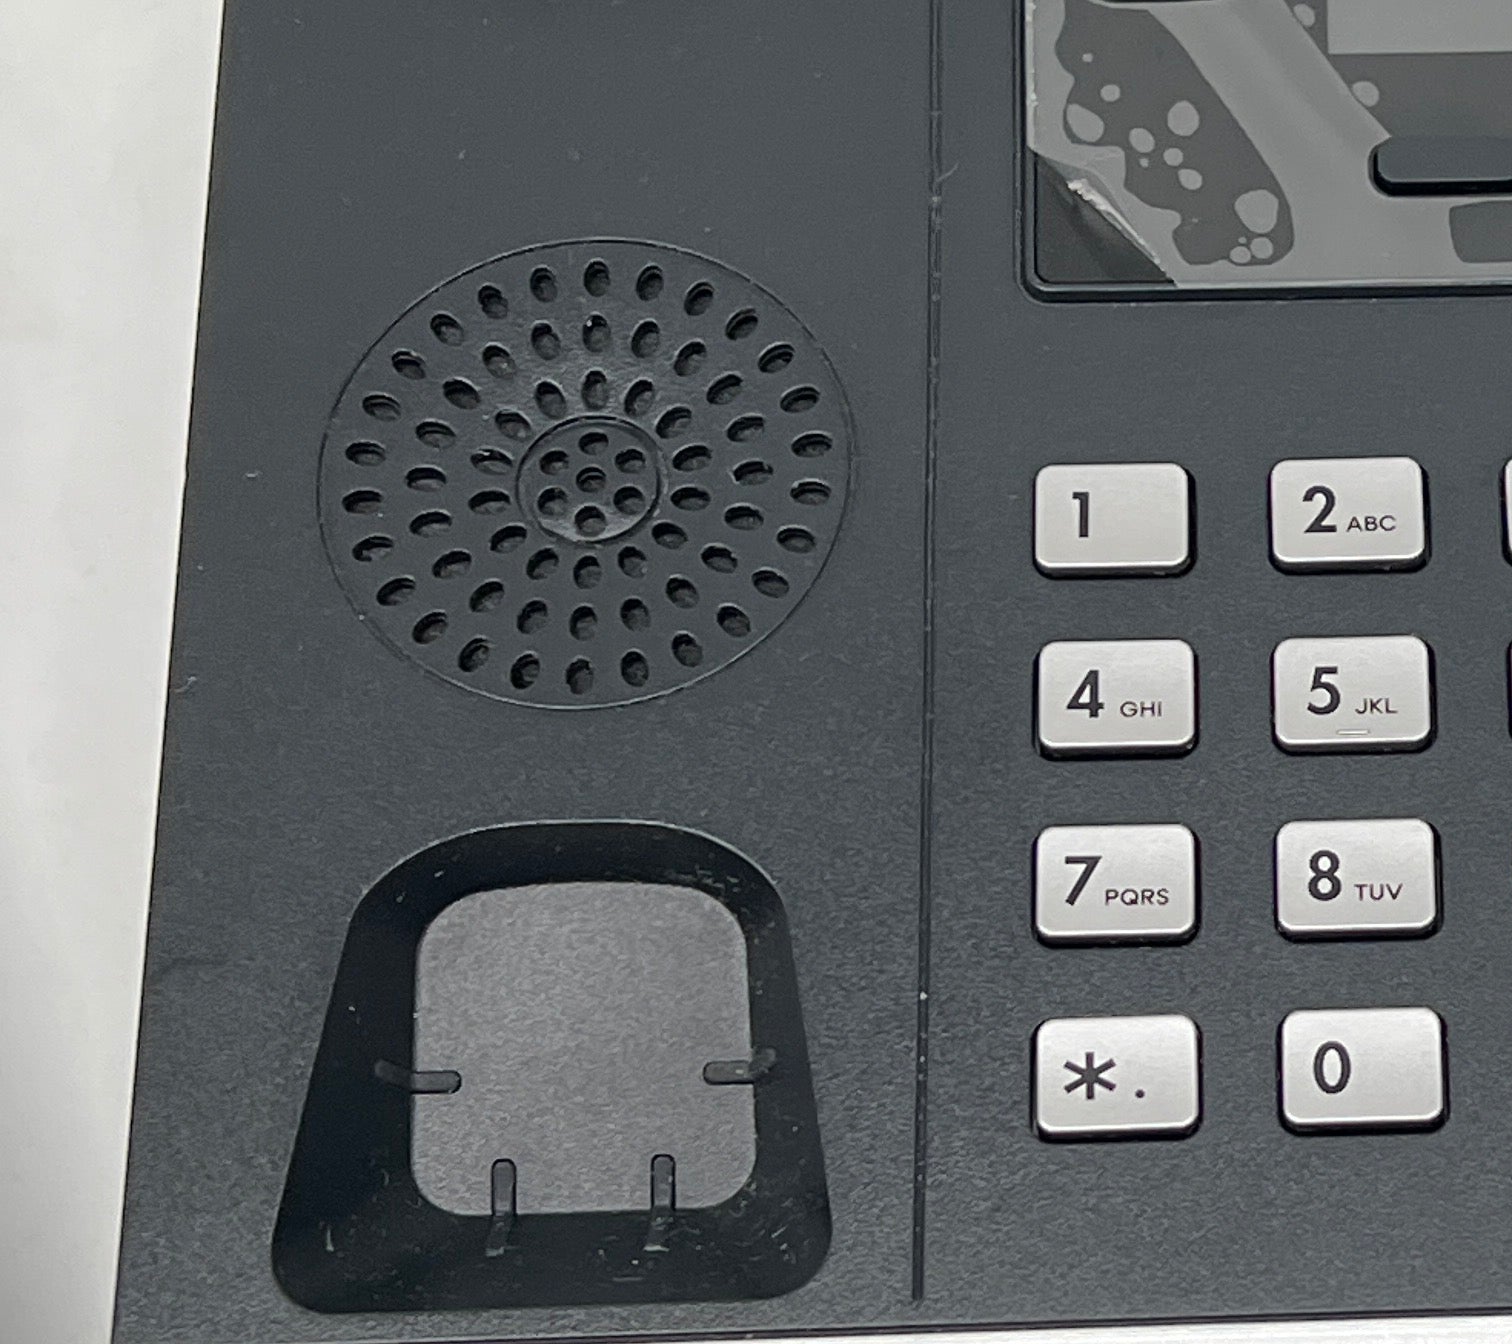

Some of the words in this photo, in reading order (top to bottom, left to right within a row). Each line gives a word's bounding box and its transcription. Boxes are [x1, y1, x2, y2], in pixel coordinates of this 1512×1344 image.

[1072, 491, 1090, 538] 1
[1302, 485, 1337, 534] 2
[1346, 515, 1396, 532] ABC
[1066, 669, 1105, 719] 4
[1119, 701, 1163, 718] GHI
[1307, 666, 1341, 716] 5
[1355, 698, 1398, 715] JKL
[1064, 856, 1102, 906] 7
[1105, 888, 1169, 906] PQRS
[1308, 850, 1342, 902] 8
[1354, 883, 1403, 901] TUV
[1313, 1041, 1351, 1094] 0
